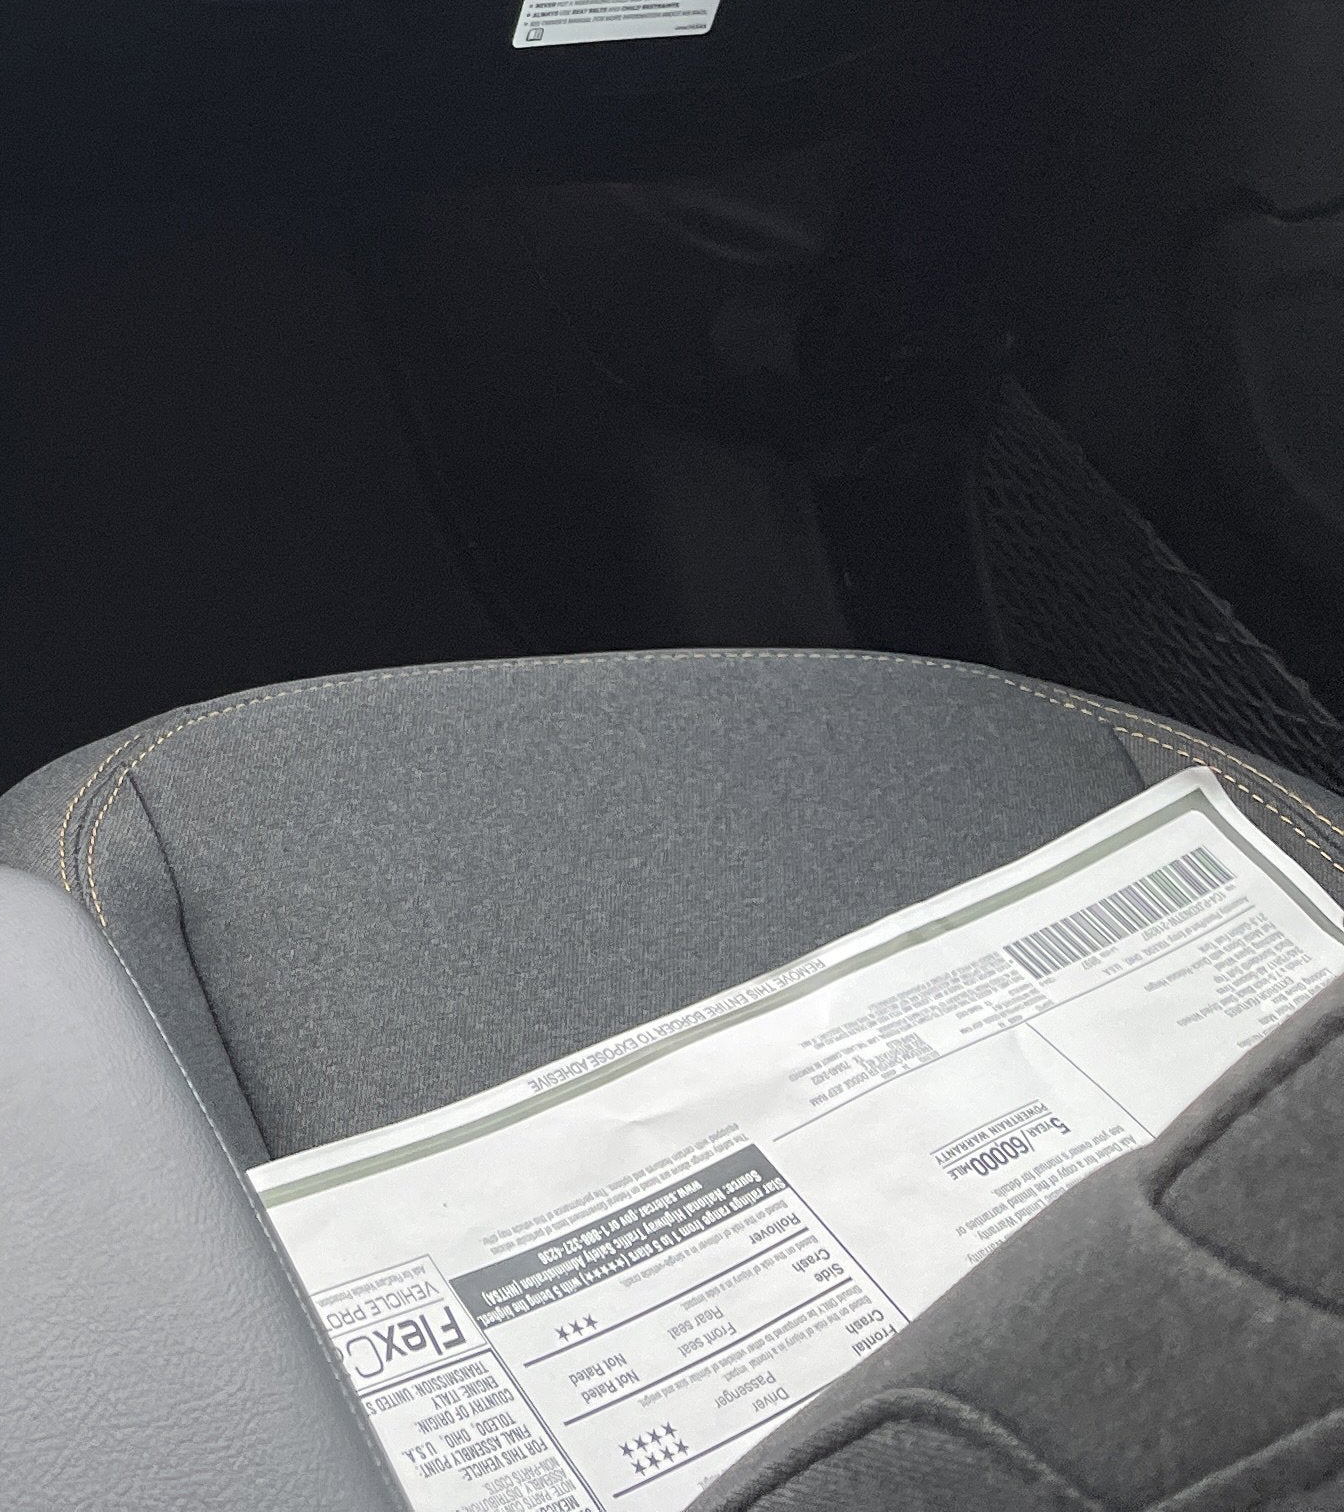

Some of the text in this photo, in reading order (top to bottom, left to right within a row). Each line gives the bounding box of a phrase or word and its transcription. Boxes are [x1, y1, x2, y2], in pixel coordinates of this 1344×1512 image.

[528, 959, 824, 1090] REMOVE THIS ENTIRE BORDER TO EXPOSE ADHESIVE
[934, 1102, 1047, 1163] POWERTRAIN WARRANTY
[700, 1203, 729, 1222] range
[727, 1187, 764, 1210] ratings
[481, 1170, 761, 1304] Source: National Highway Traffic Safety Administration (NHTSA)
[660, 1235, 673, 1246] to
[678, 1220, 703, 1237] from
[748, 1213, 799, 1245] Rollover
[792, 1249, 829, 1272] Crash
[813, 1263, 843, 1283] Side
[525, 1288, 553, 1306] being
[560, 1277, 582, 1292] with
[319, 1279, 438, 1332] VEHICLE PRO
[512, 1300, 528, 1312] the
[667, 1307, 722, 1338] Rear seat
[845, 1310, 883, 1335] Crash
[336, 1305, 466, 1379] FlexC
[678, 1322, 735, 1355] Front seat
[851, 1324, 896, 1355] Frontal
[569, 1354, 625, 1385] Not Rated
[374, 1360, 488, 1411] TRANSMISSION: UNITED
[430, 1375, 498, 1409] ENGINE: ITALY
[581, 1371, 638, 1402] Not Rated
[713, 1370, 774, 1408] Passenger
[753, 1388, 786, 1412] Driver
[413, 1388, 513, 1434] COUNTRY OF ORIGIN:
[400, 1411, 515, 1463] TOLEDO, OHIO, U.S.A.
[414, 1424, 530, 1478] FINAL ASSEMBLY POINT:
[457, 1437, 546, 1481] FOR THIS VEHICLE:
